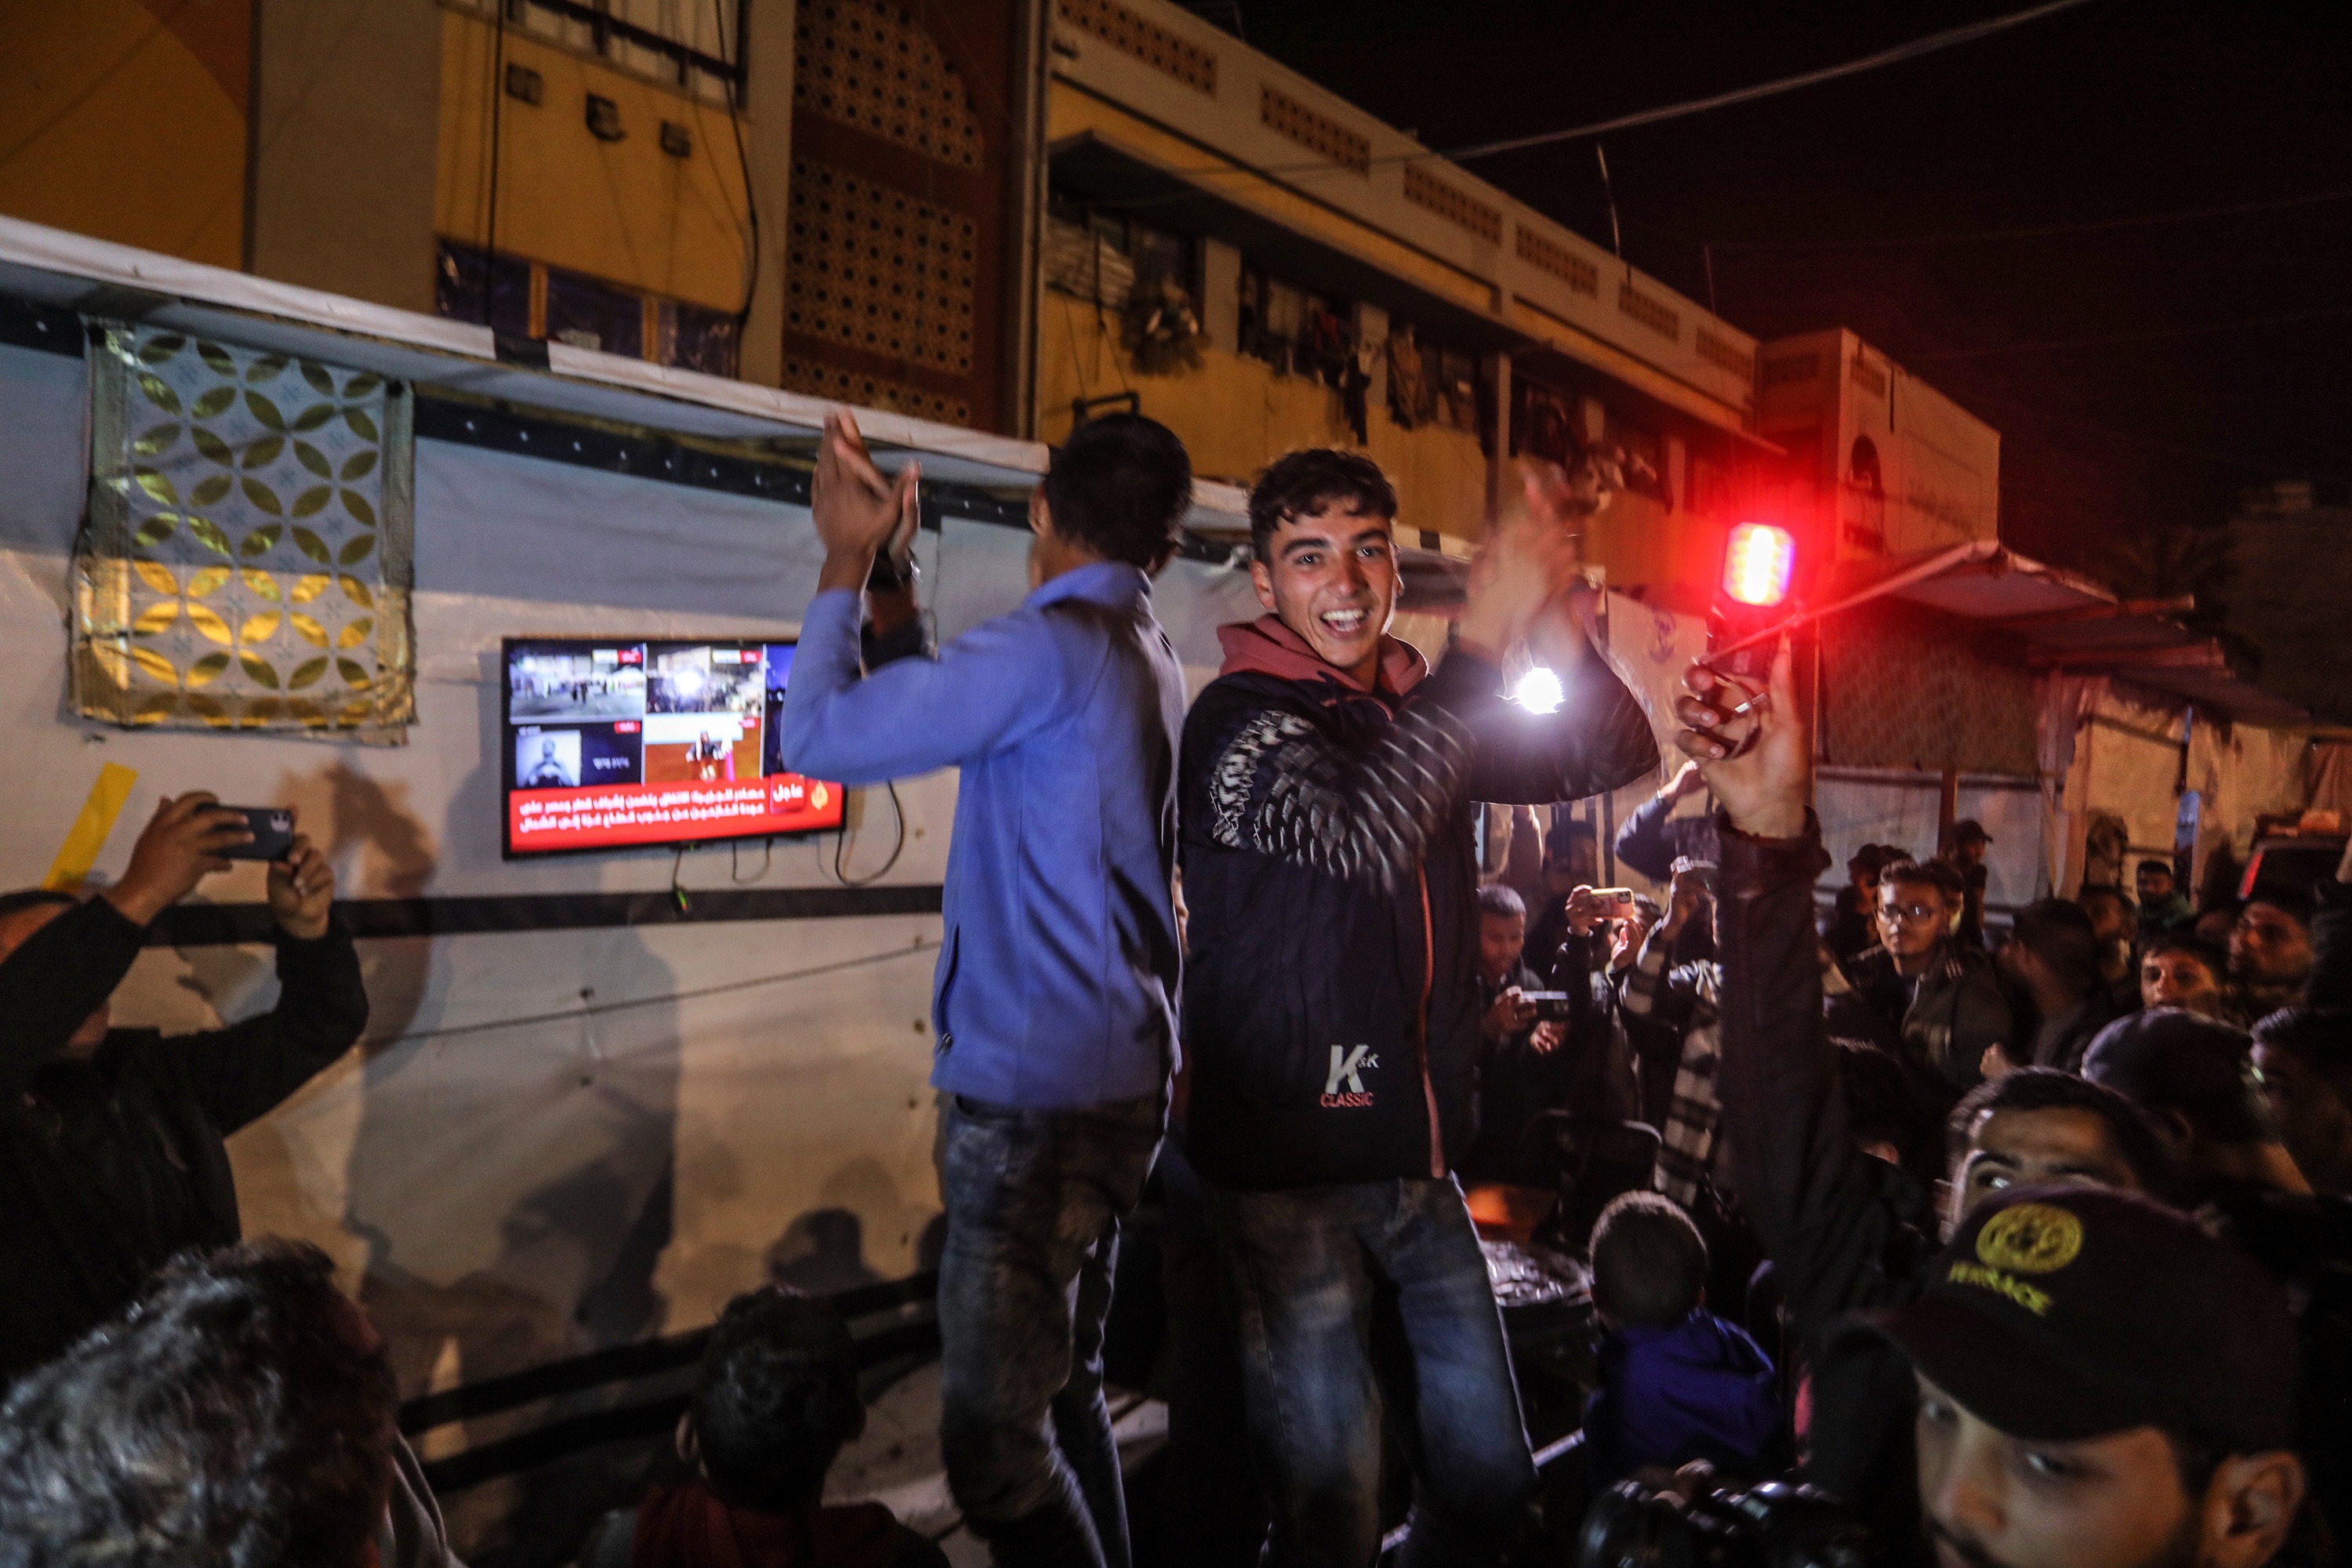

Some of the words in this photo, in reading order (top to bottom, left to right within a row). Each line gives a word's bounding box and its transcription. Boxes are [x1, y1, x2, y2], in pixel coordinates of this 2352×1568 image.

[772, 782, 804, 803] عاجل
[581, 811, 602, 829] غزة
[603, 810, 636, 829] قطاع
[671, 807, 690, 822] من
[1320, 1091, 1374, 1108] CLASSIC
